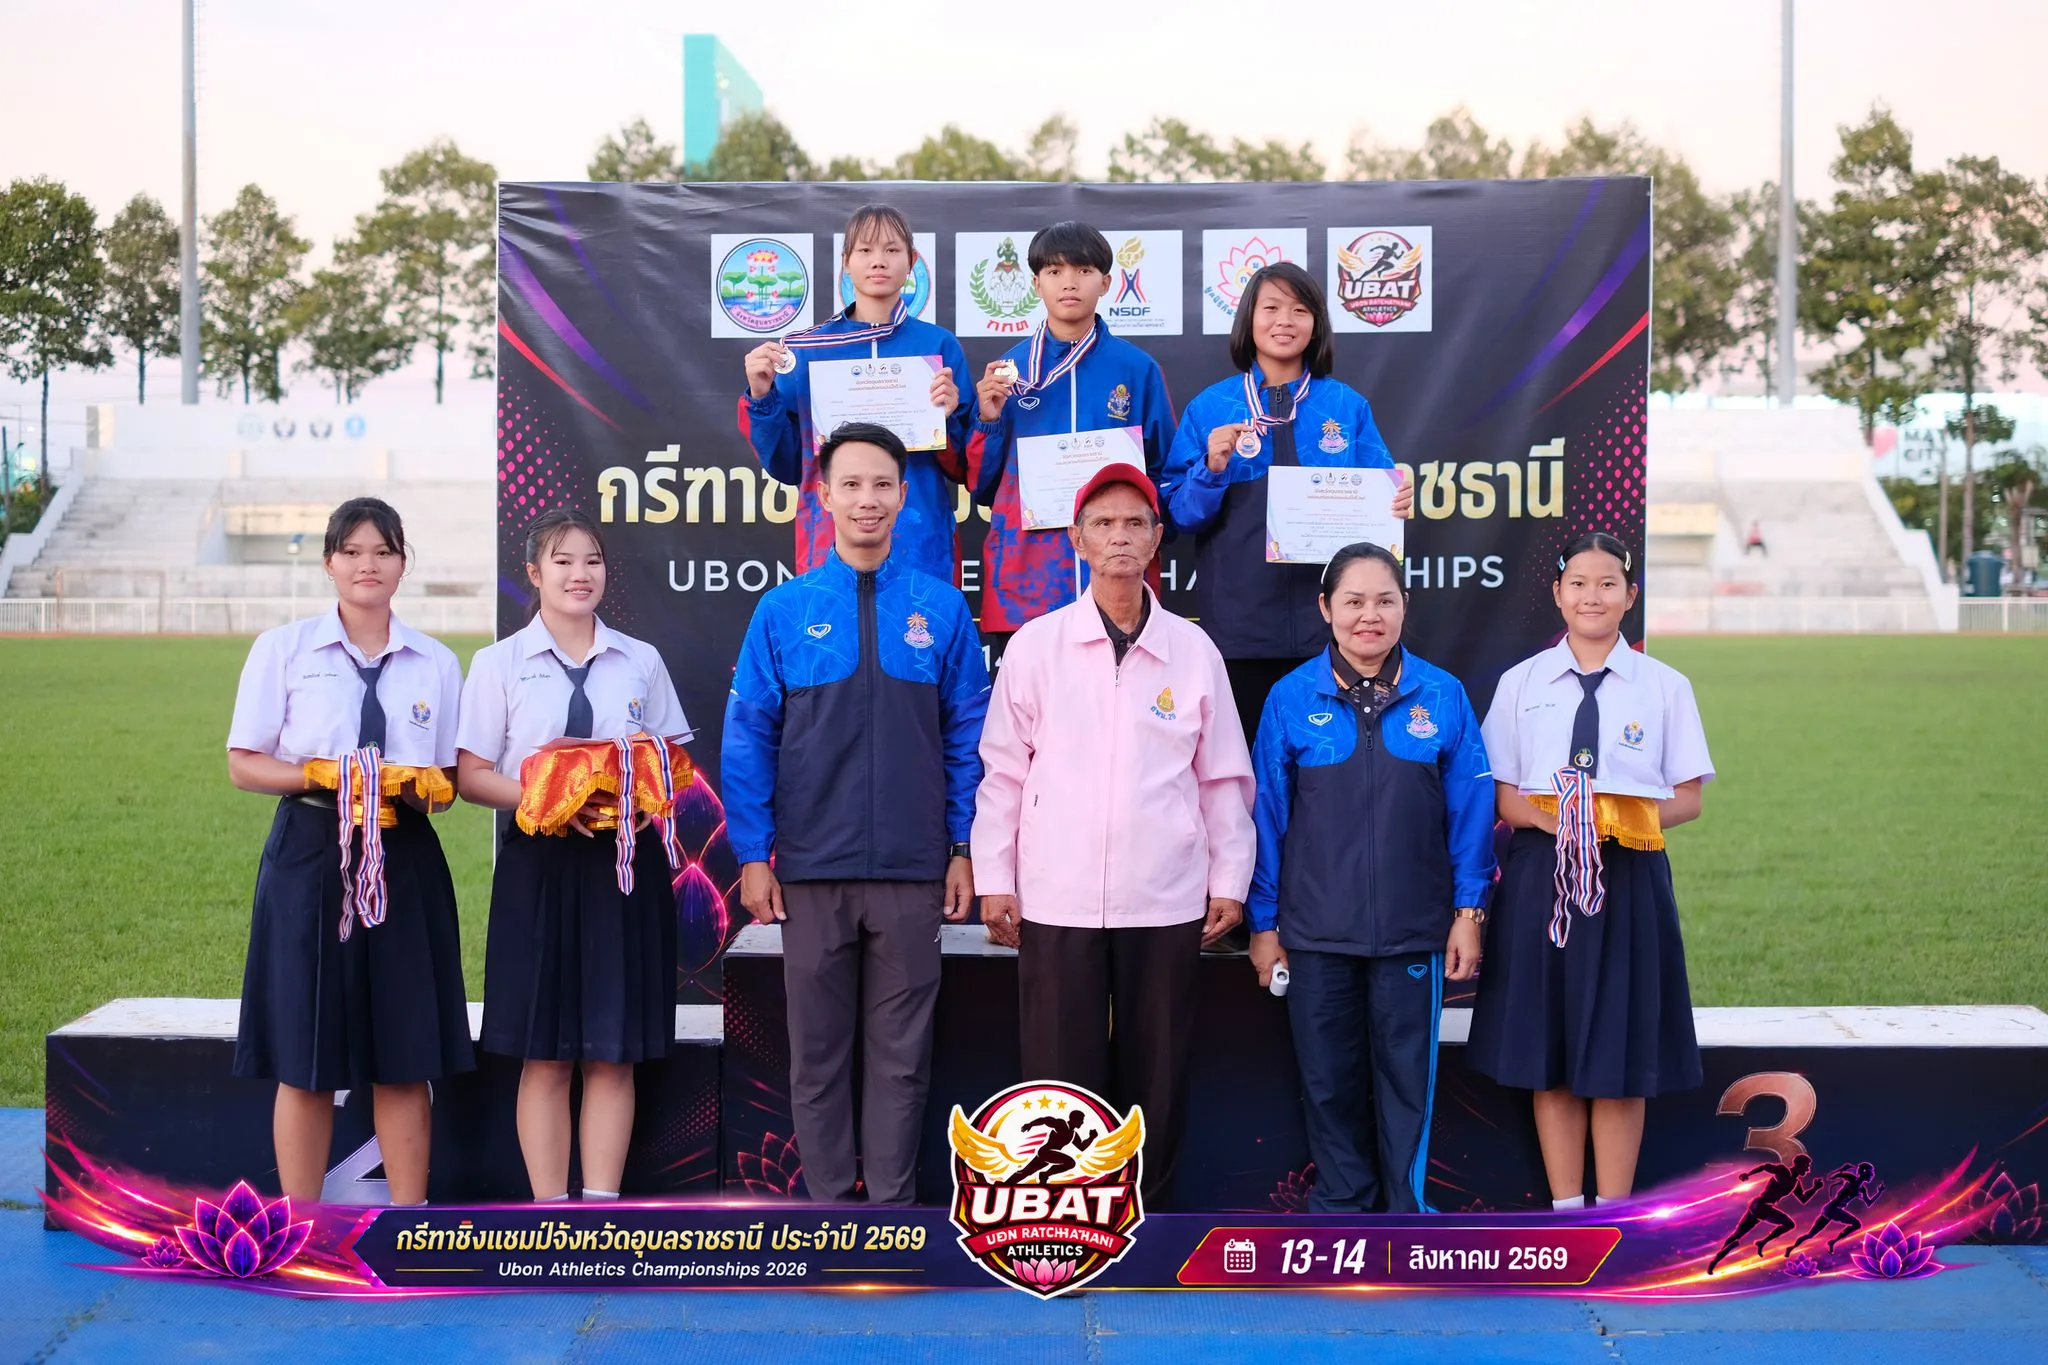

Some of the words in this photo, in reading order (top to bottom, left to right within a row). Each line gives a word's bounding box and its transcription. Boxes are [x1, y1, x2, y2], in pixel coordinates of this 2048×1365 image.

[1344, 280, 1416, 299] UBAT
[1109, 307, 1151, 316] NSDF
[1716, 1071, 1817, 1166] 3
